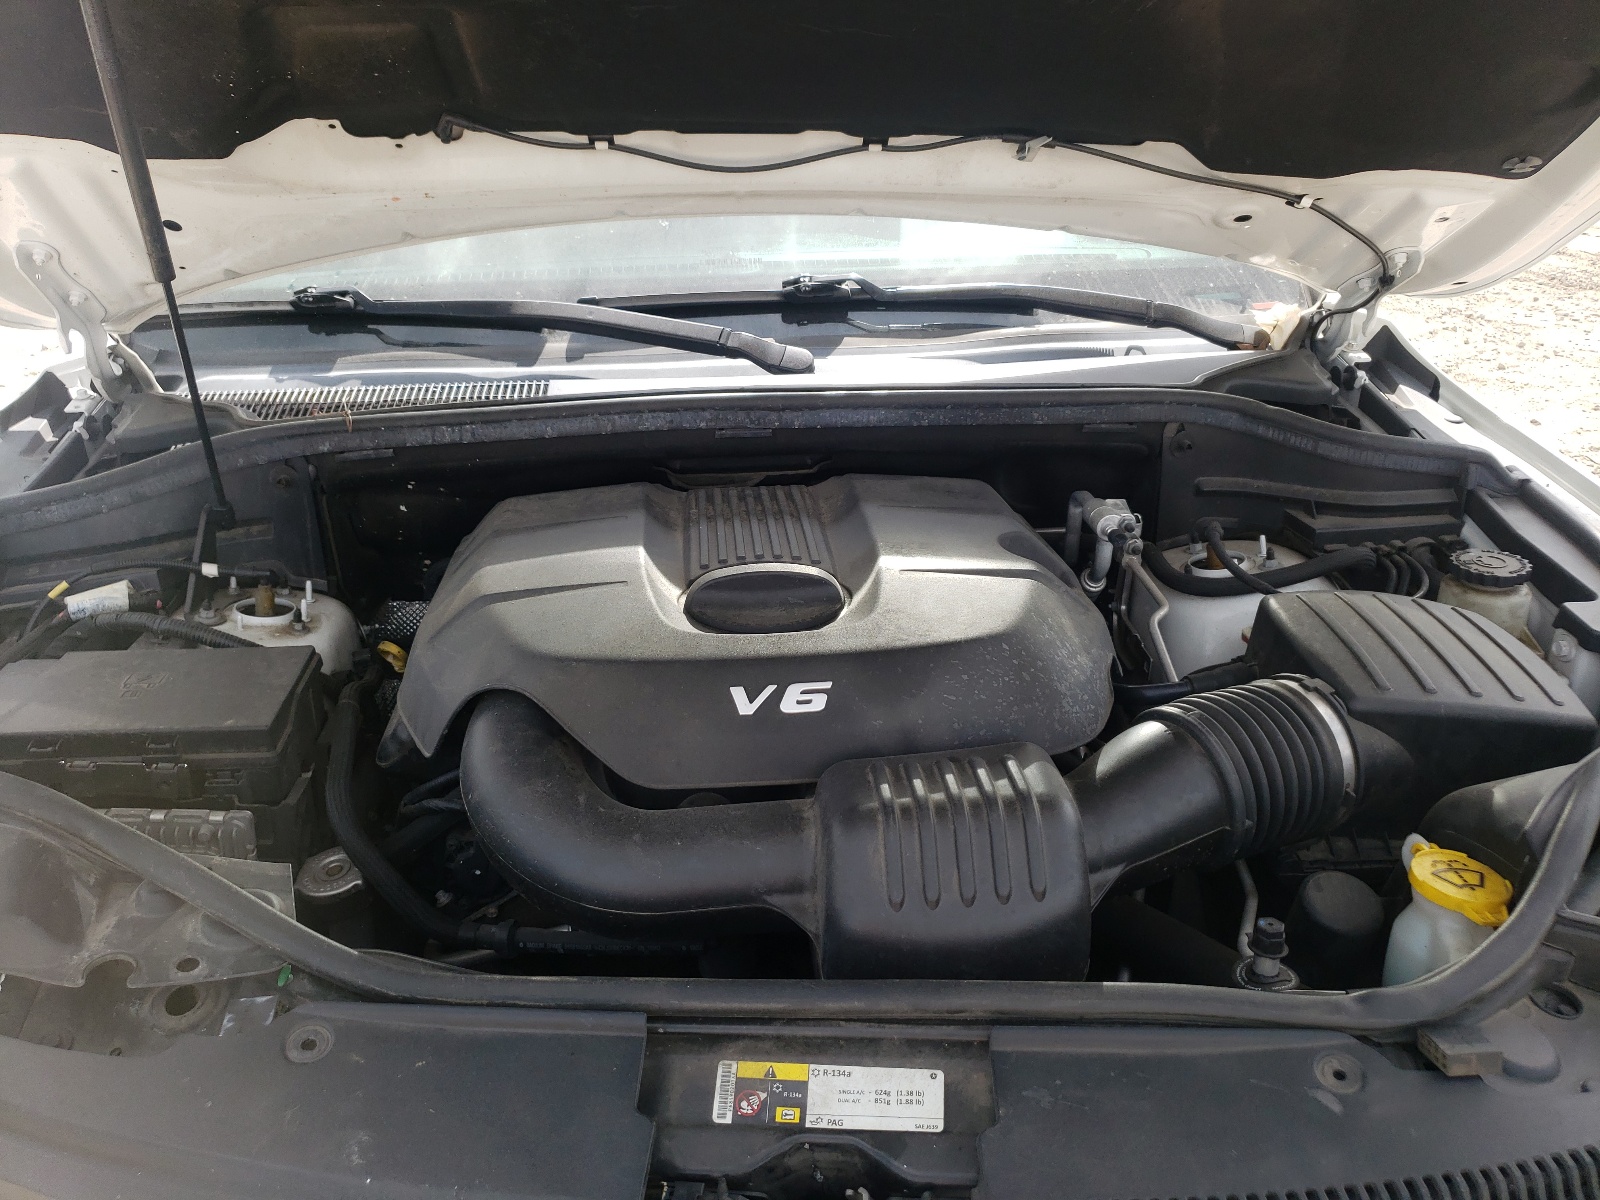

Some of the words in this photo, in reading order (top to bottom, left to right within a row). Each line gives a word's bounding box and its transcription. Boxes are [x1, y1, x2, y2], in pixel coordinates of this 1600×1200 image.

[729, 681, 833, 715] V6
[823, 1069, 851, 1078] R-134a
[874, 1089, 891, 1097] 624g
[896, 1089, 914, 1097] (1.38
[915, 1089, 925, 1098] lb)
[874, 1097, 891, 1106] 851g
[896, 1098, 914, 1106] (1.88
[915, 1098, 925, 1106] lb)
[827, 1118, 844, 1127] PAG
